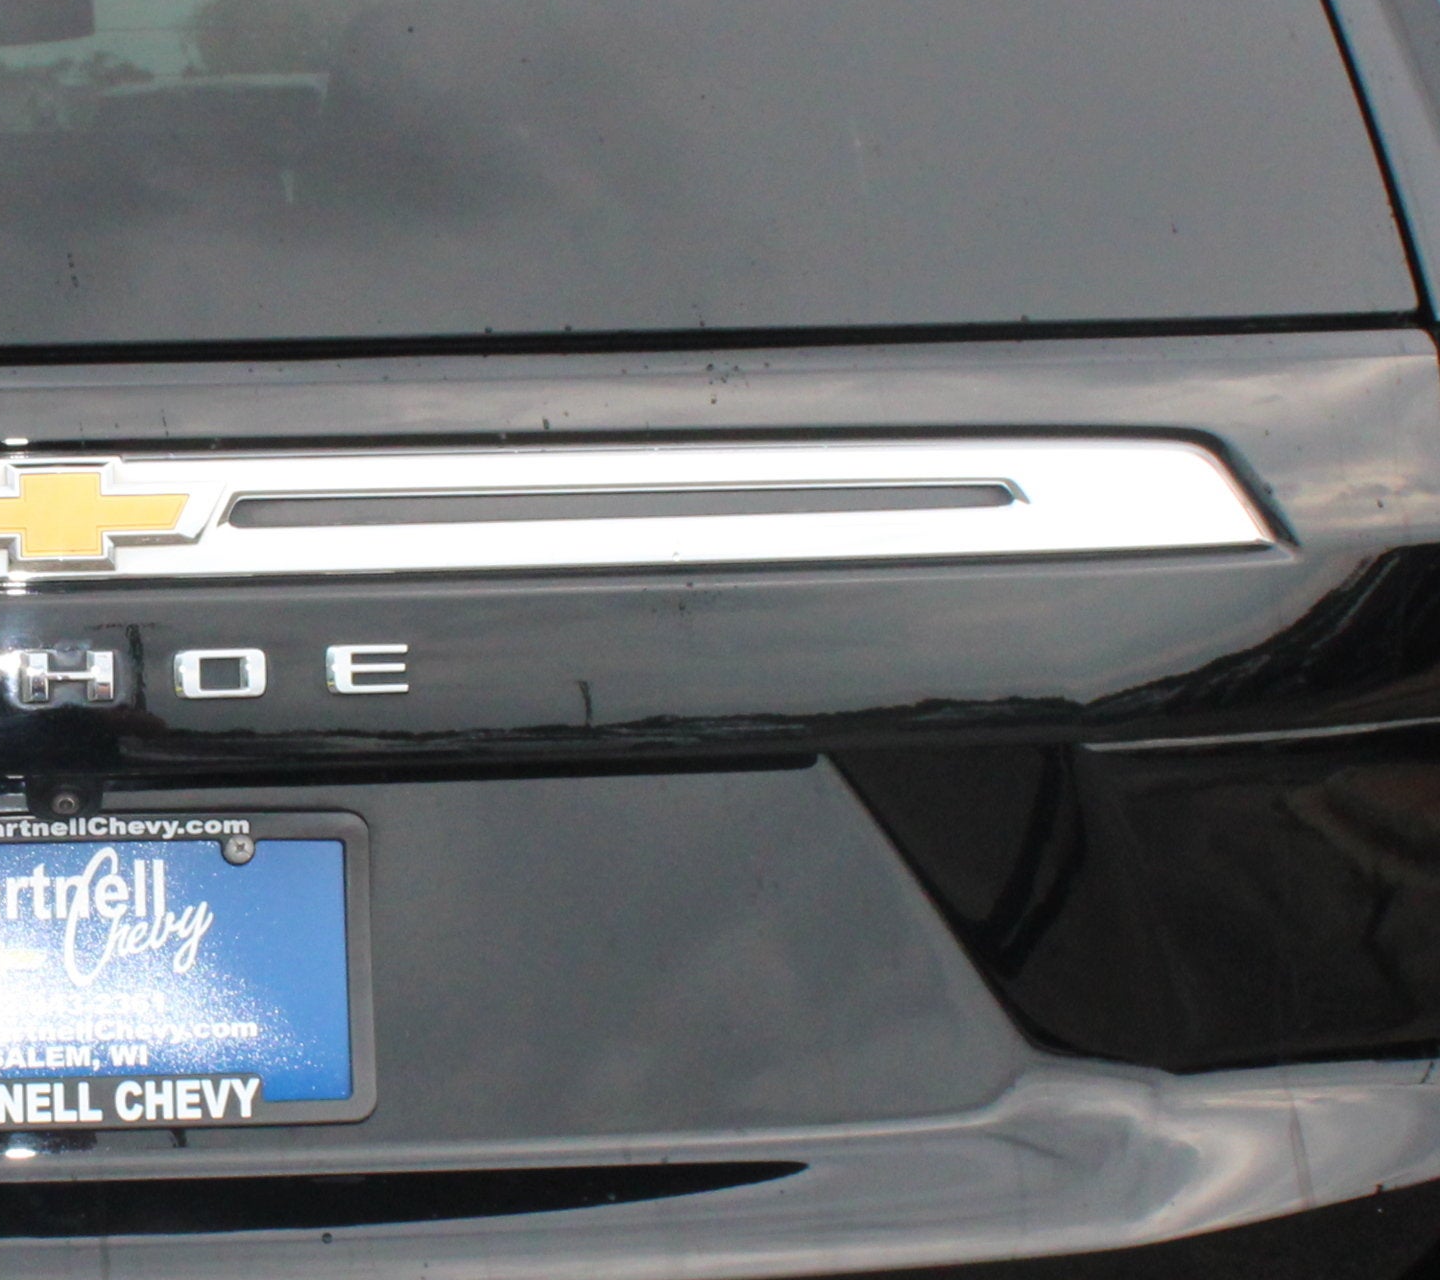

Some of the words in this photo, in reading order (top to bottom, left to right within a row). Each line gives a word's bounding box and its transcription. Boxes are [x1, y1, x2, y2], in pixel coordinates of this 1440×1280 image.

[63, 846, 215, 988] Chevy
[109, 1045, 149, 1067] WI
[114, 1077, 261, 1122] CHEVY
